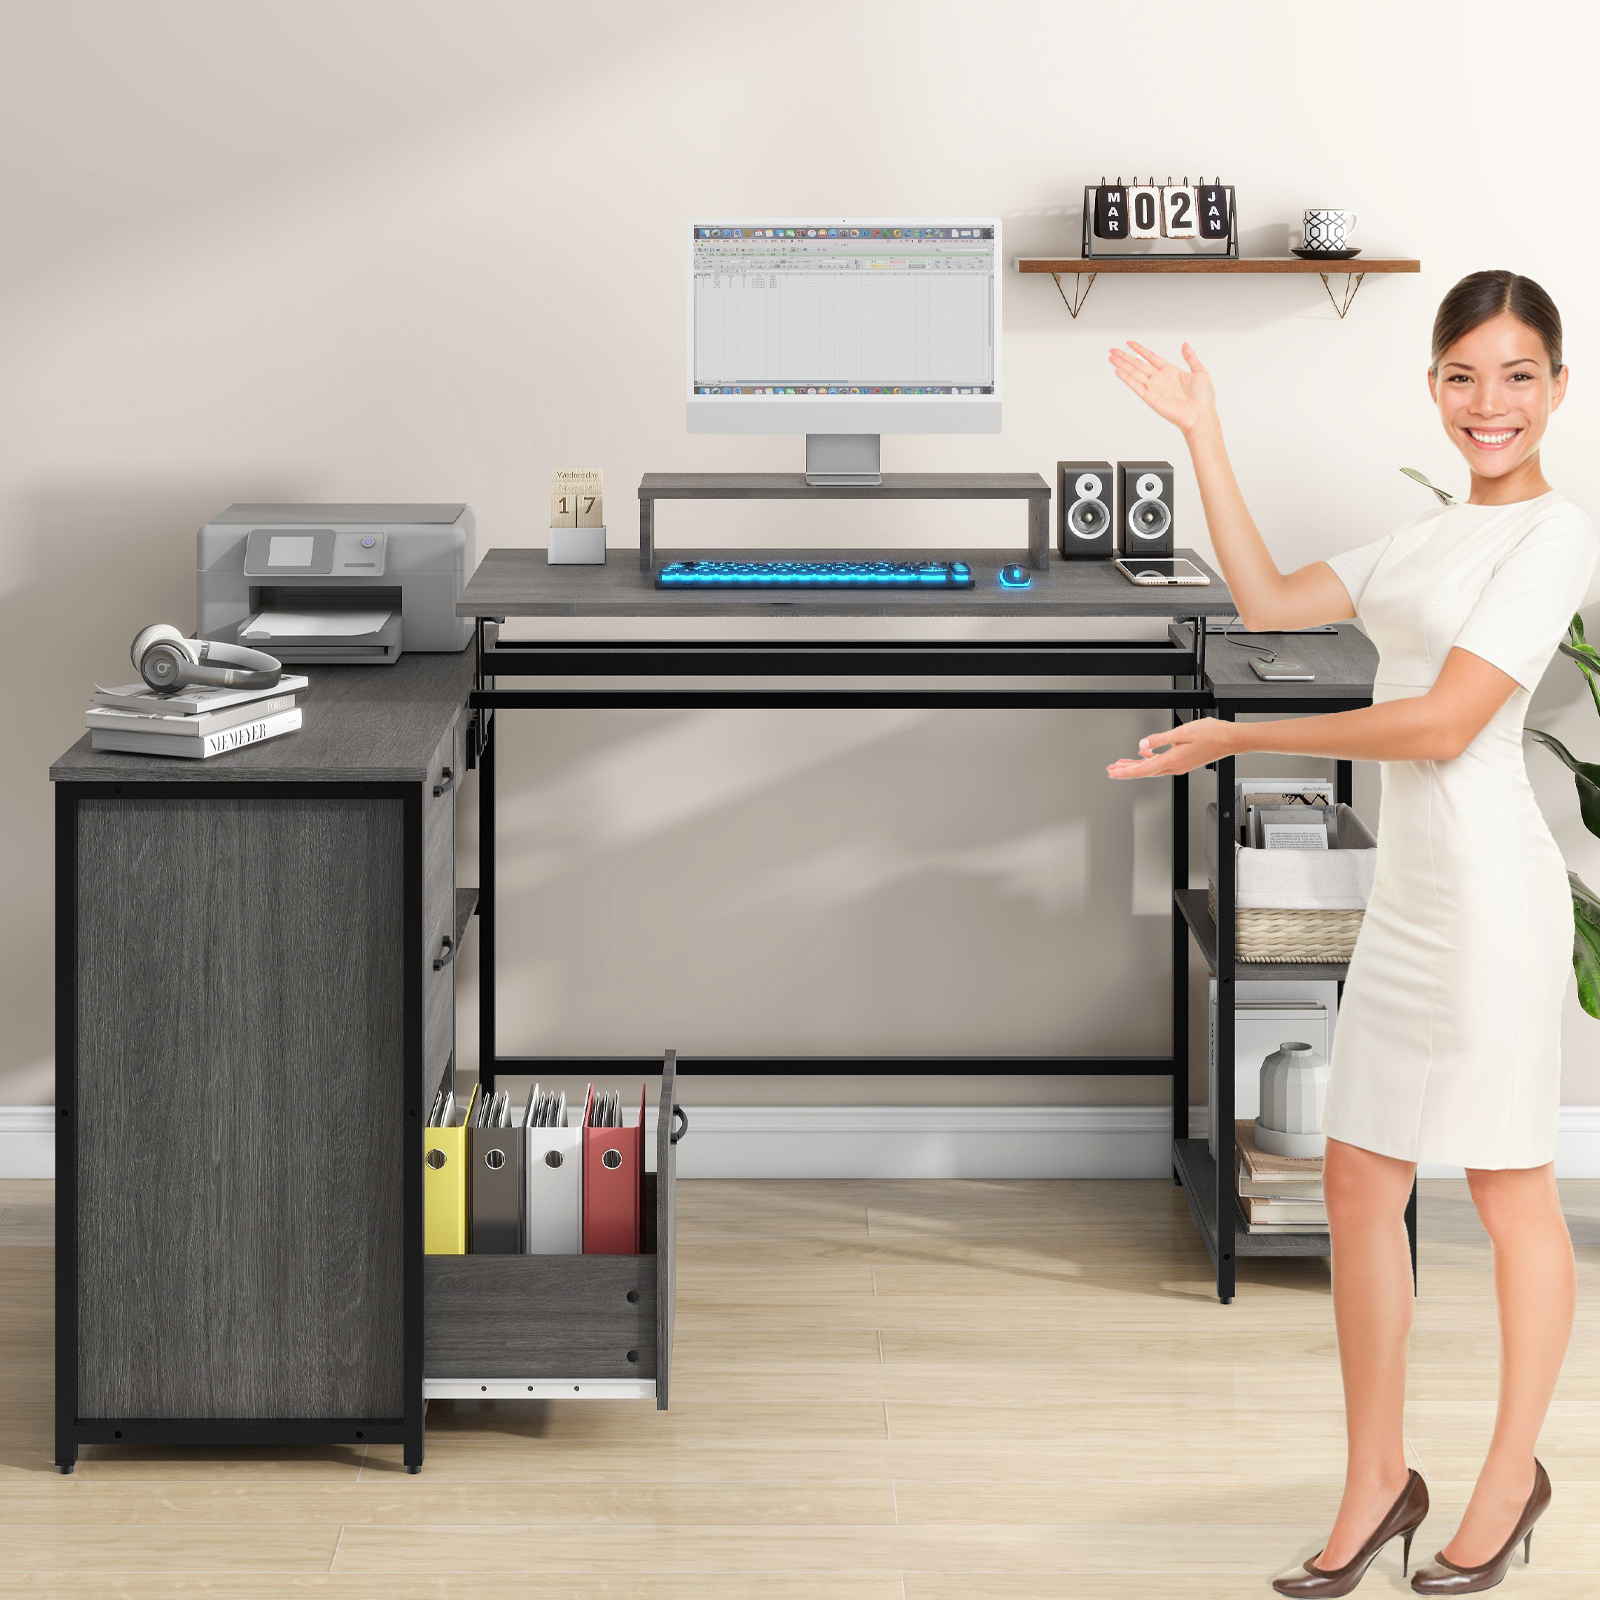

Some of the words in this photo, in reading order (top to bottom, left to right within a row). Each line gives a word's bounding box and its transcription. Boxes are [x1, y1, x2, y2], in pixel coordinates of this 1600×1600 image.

[1107, 192, 1120, 231] MAR
[1207, 191, 1221, 231] JAN
[556, 471, 599, 480] Wednesday
